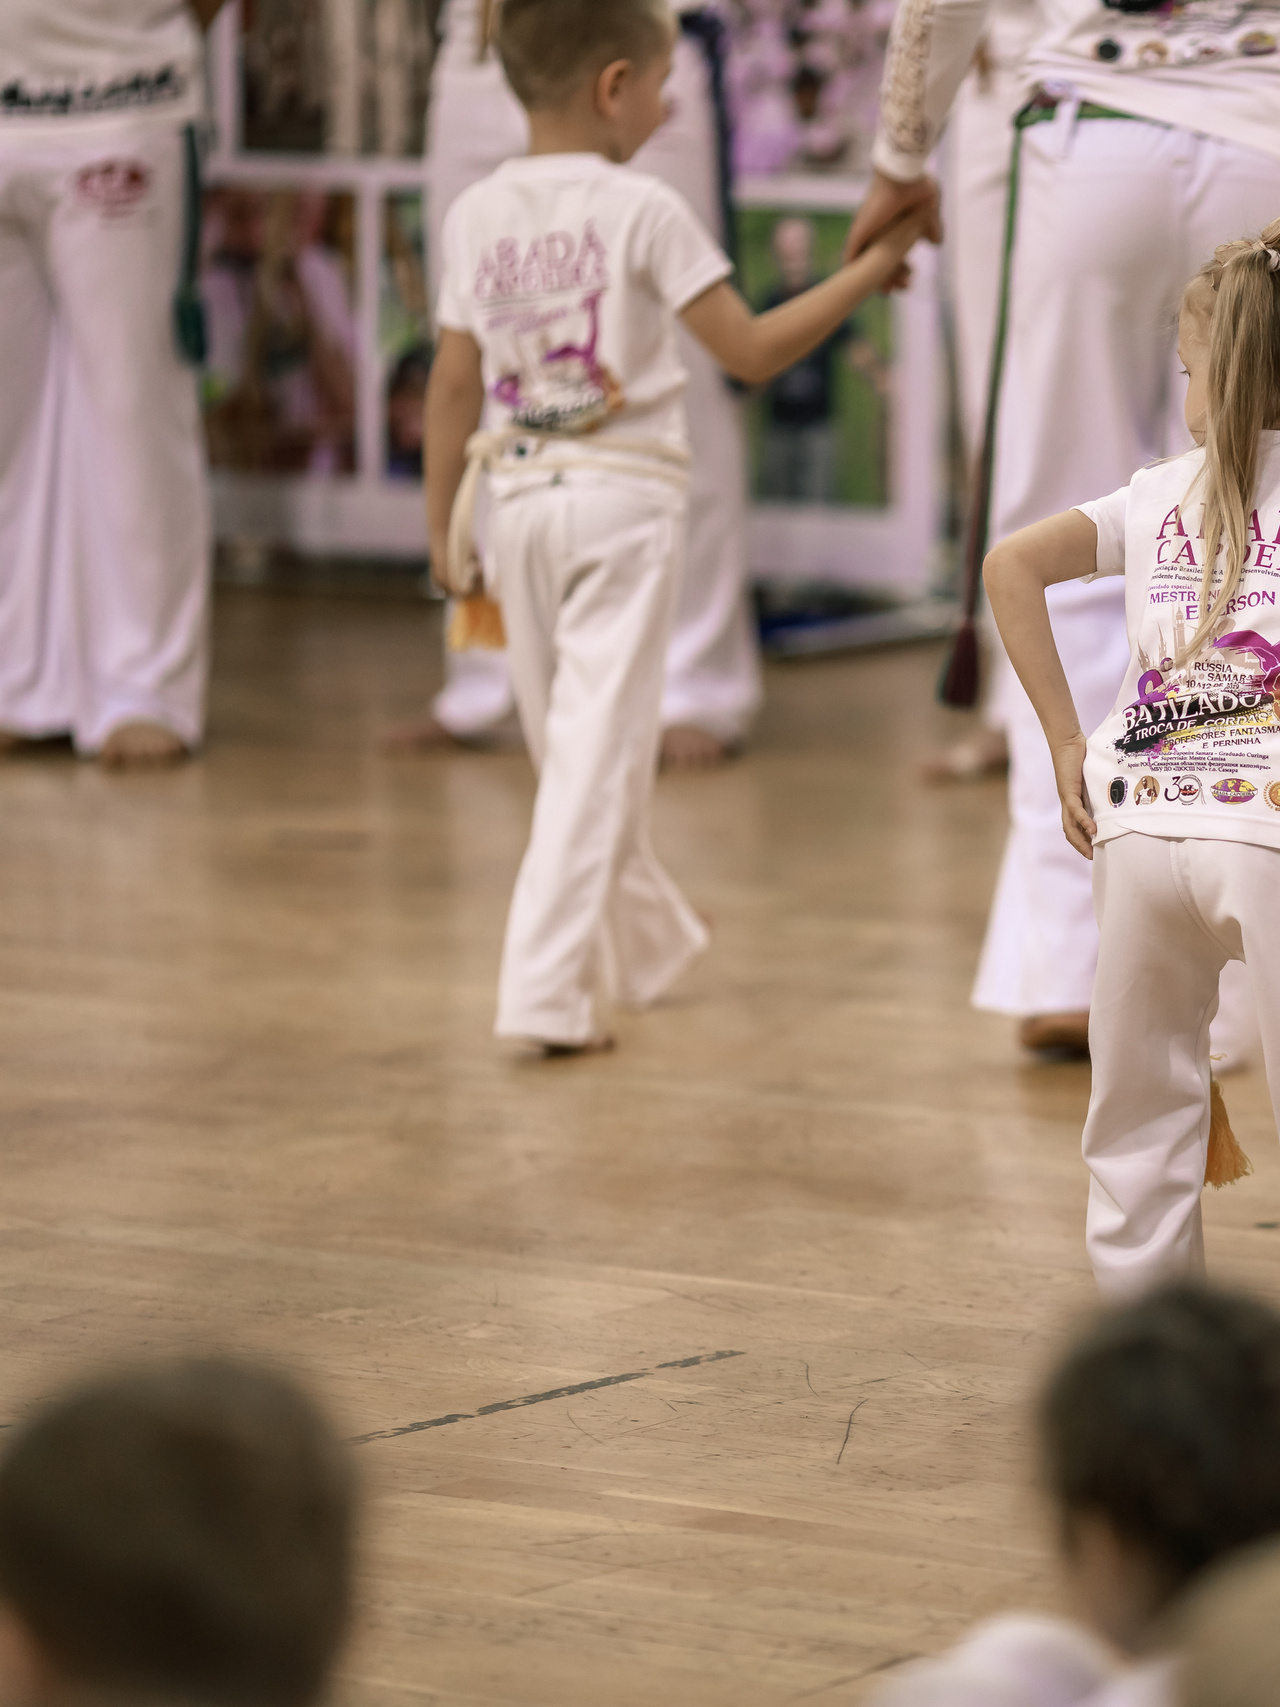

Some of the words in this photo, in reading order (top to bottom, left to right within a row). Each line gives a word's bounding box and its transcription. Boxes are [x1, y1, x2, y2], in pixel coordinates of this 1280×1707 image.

[1179, 566, 1204, 574] Brasilei
[1186, 591, 1276, 620] ERSON
[1194, 659, 1232, 672] RÚSSIA
[1207, 673, 1253, 682] SAMARA
[1186, 680, 1196, 688] 10
[1123, 691, 1262, 732] BATIZADO
[1123, 734, 1132, 745] E
[1136, 722, 1174, 740] TROCA
[1177, 719, 1197, 732] DE
[1203, 712, 1268, 727] CORDAS
[1163, 731, 1226, 746] PROFESSORES
[1213, 737, 1261, 748] PERNINHA
[1246, 752, 1269, 760] Curinga
